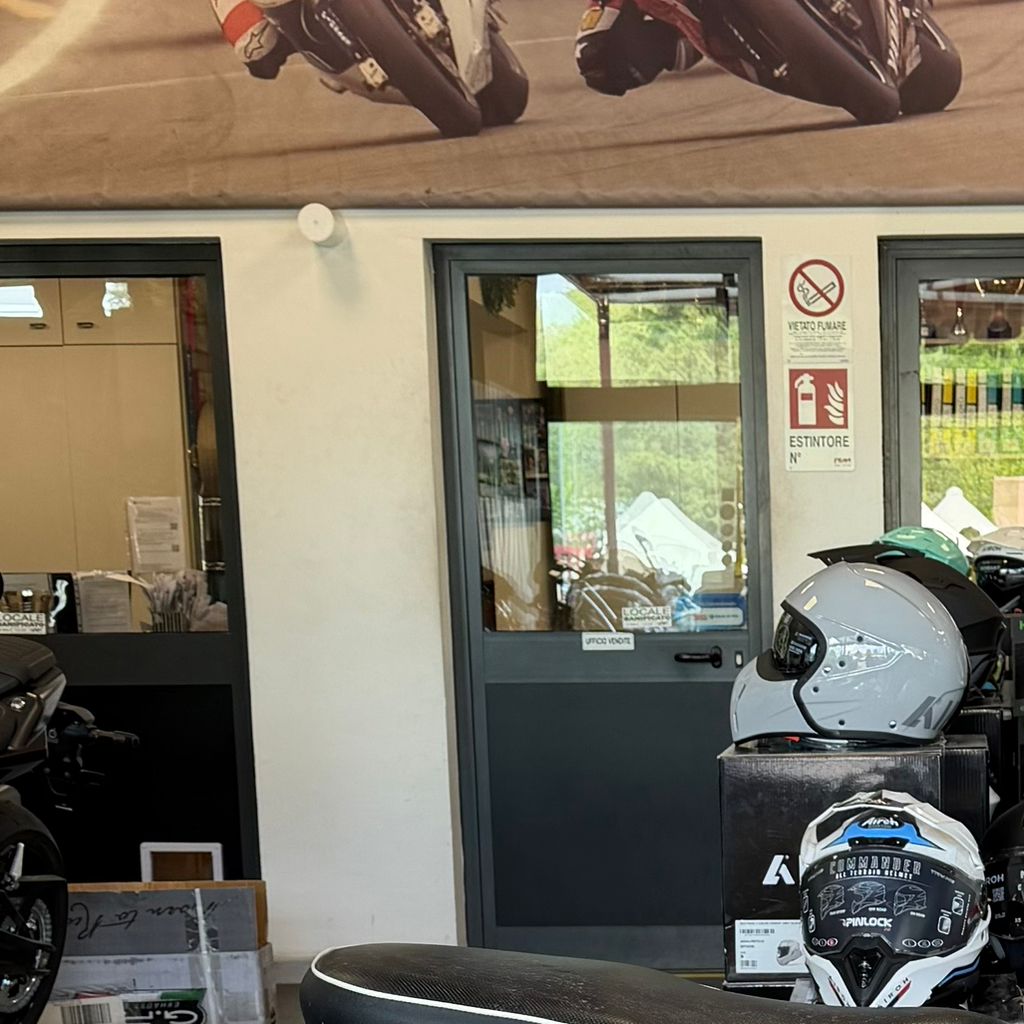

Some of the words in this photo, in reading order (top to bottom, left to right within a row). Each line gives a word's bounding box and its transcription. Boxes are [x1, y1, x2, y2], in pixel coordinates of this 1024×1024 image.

[787, 321, 816, 331] VIETATO
[817, 321, 847, 331] FUMARE
[789, 435, 850, 448] ESTINTORE
[829, 856, 922, 876] COMMANDER
[846, 917, 894, 928] PINLOCK
